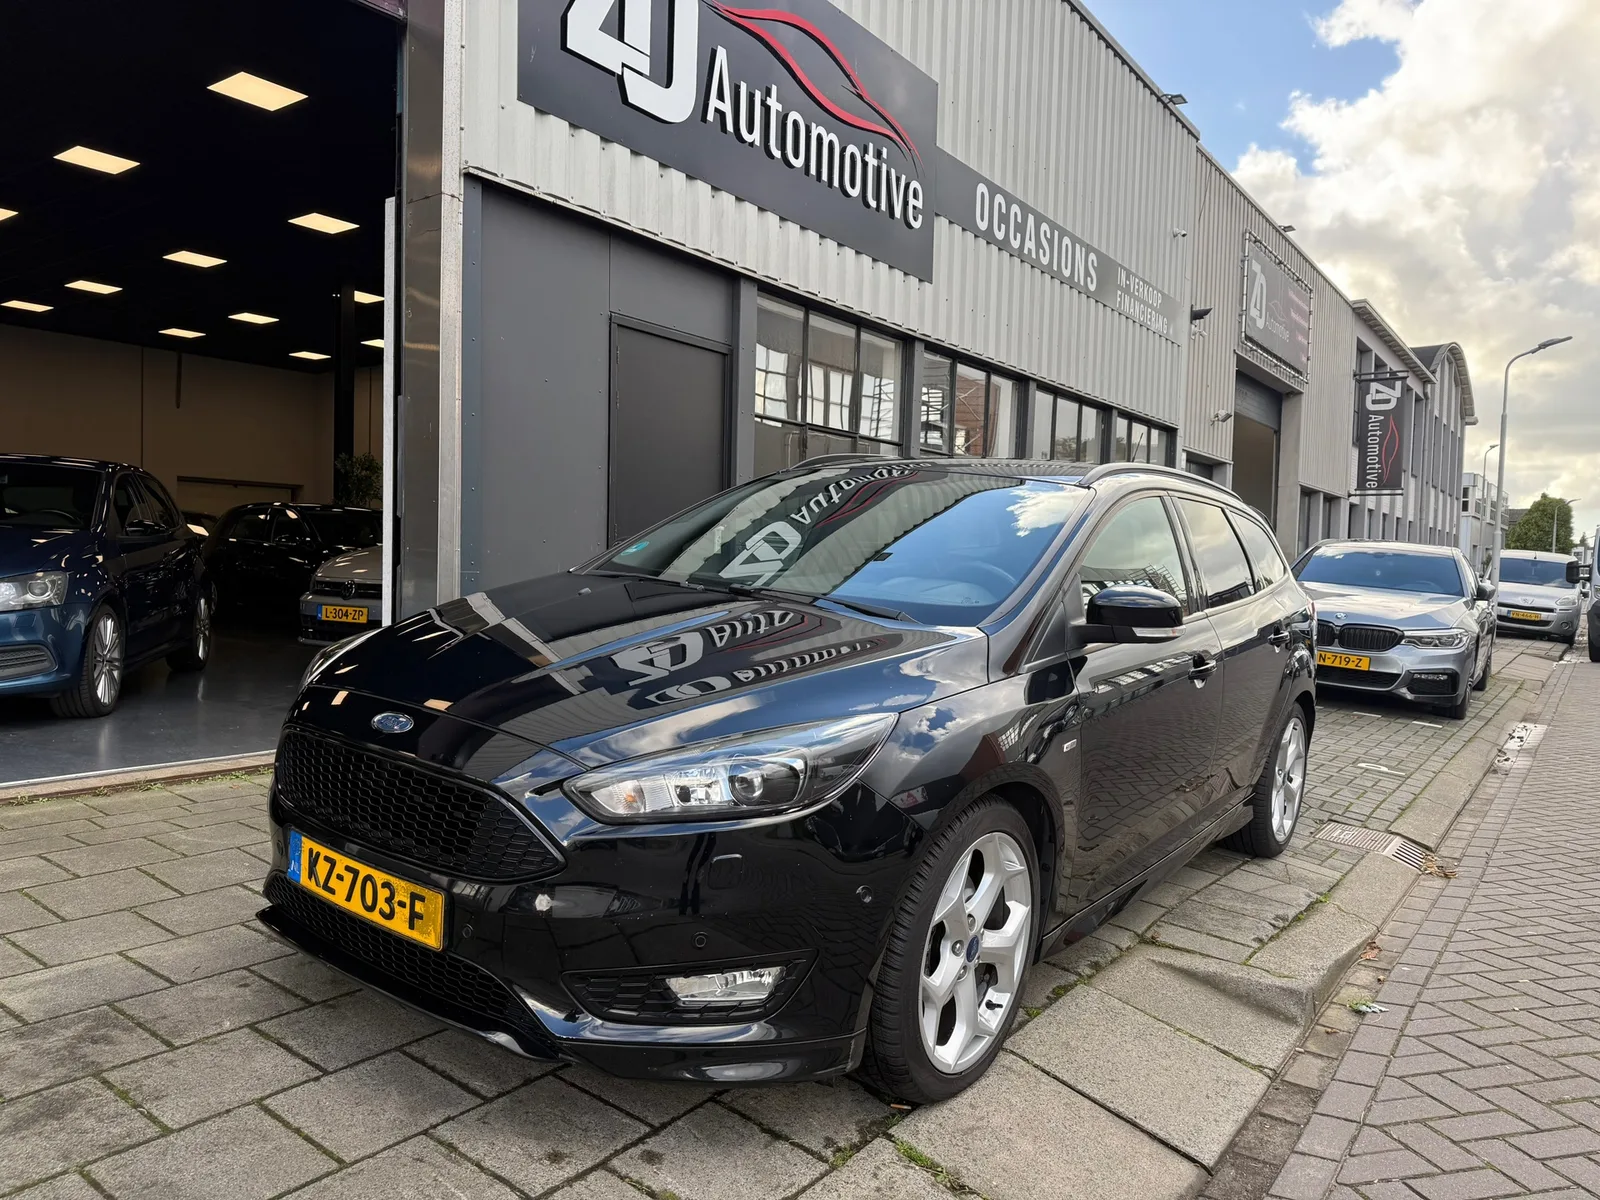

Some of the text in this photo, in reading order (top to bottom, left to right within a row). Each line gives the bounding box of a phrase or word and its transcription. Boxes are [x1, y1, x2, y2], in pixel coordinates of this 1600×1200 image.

[706, 45, 923, 229] Automotive
[975, 183, 1097, 291] OCCASIONS
[1116, 289, 1168, 334] FINANCIERING
[1117, 267, 1162, 309] IN-VERKOOP
[1365, 414, 1385, 489] Automotive
[324, 607, 364, 620] L-304-ZP
[1317, 653, 1363, 668] N-719-Z
[308, 847, 427, 931] KZ-703-F
